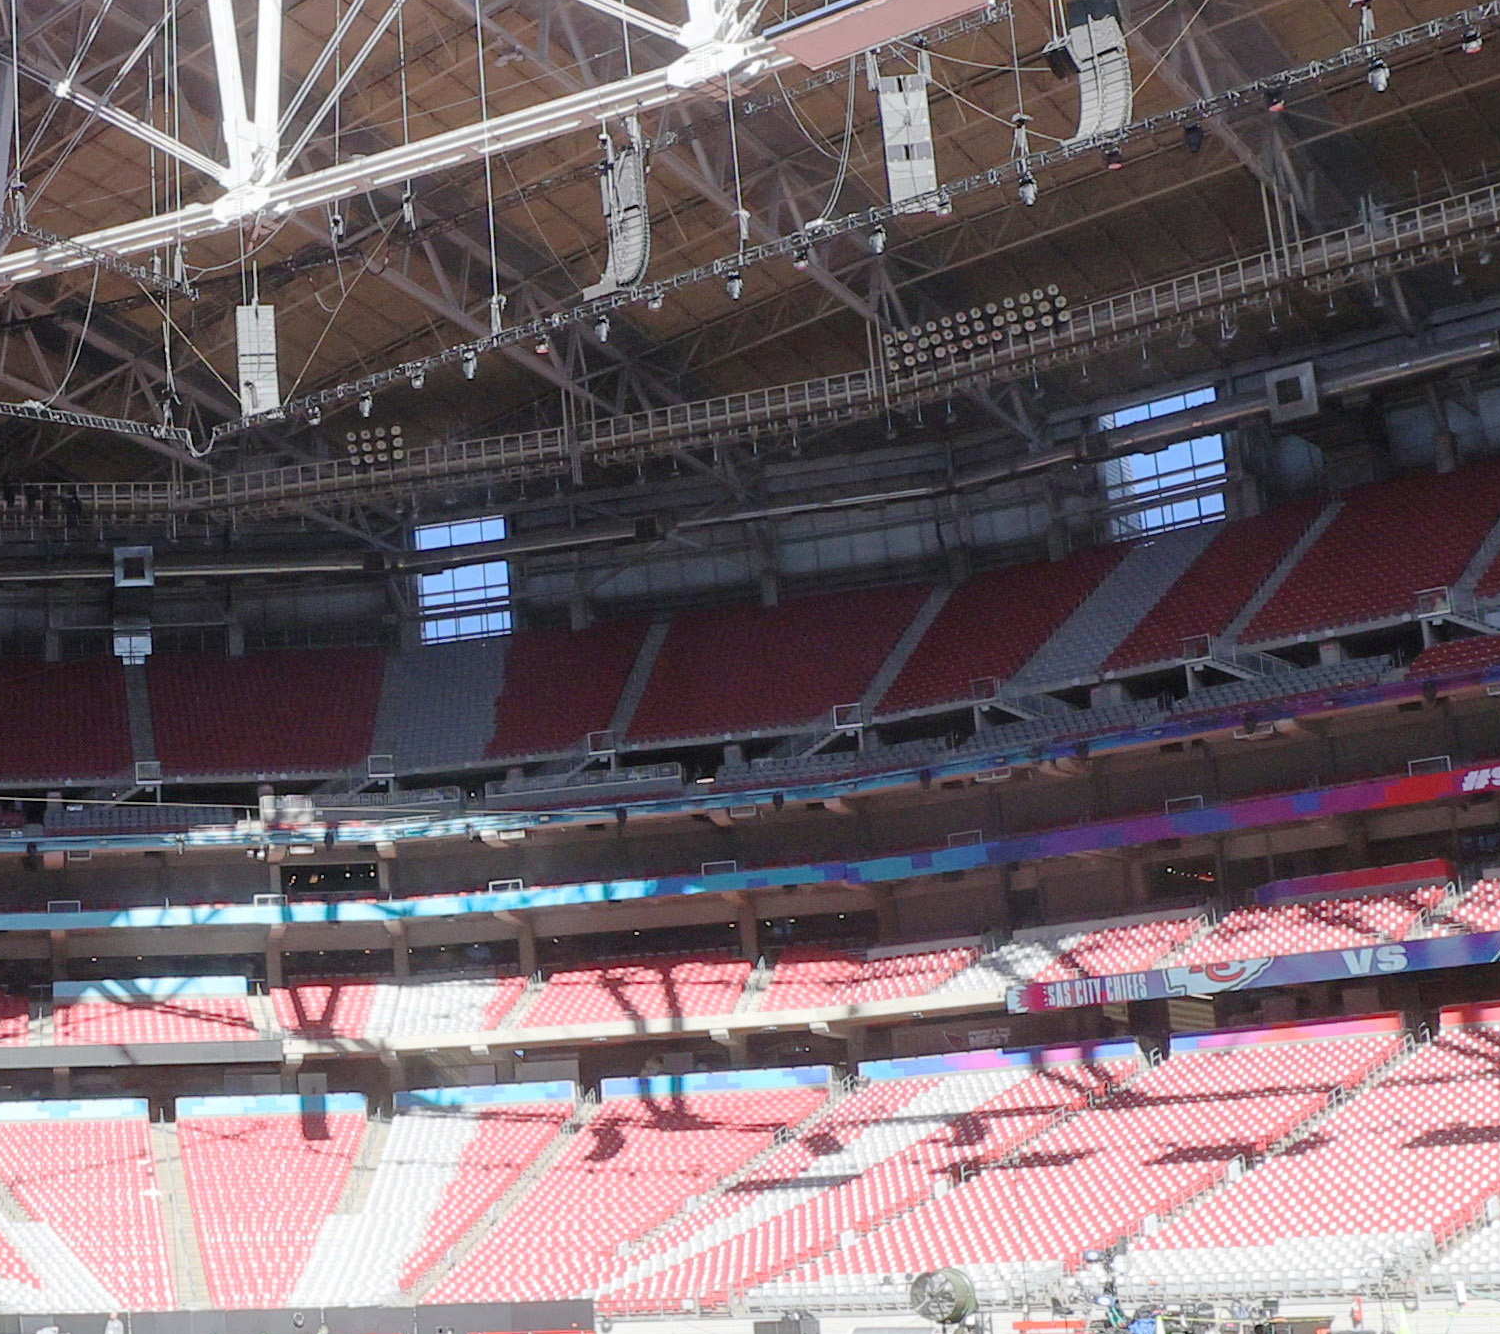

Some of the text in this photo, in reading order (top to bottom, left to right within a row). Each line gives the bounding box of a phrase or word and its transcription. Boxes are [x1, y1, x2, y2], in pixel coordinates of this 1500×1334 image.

[1341, 944, 1409, 976] VS
[1075, 978, 1102, 1005] CITY
[1106, 972, 1148, 1002] CHIEFS
